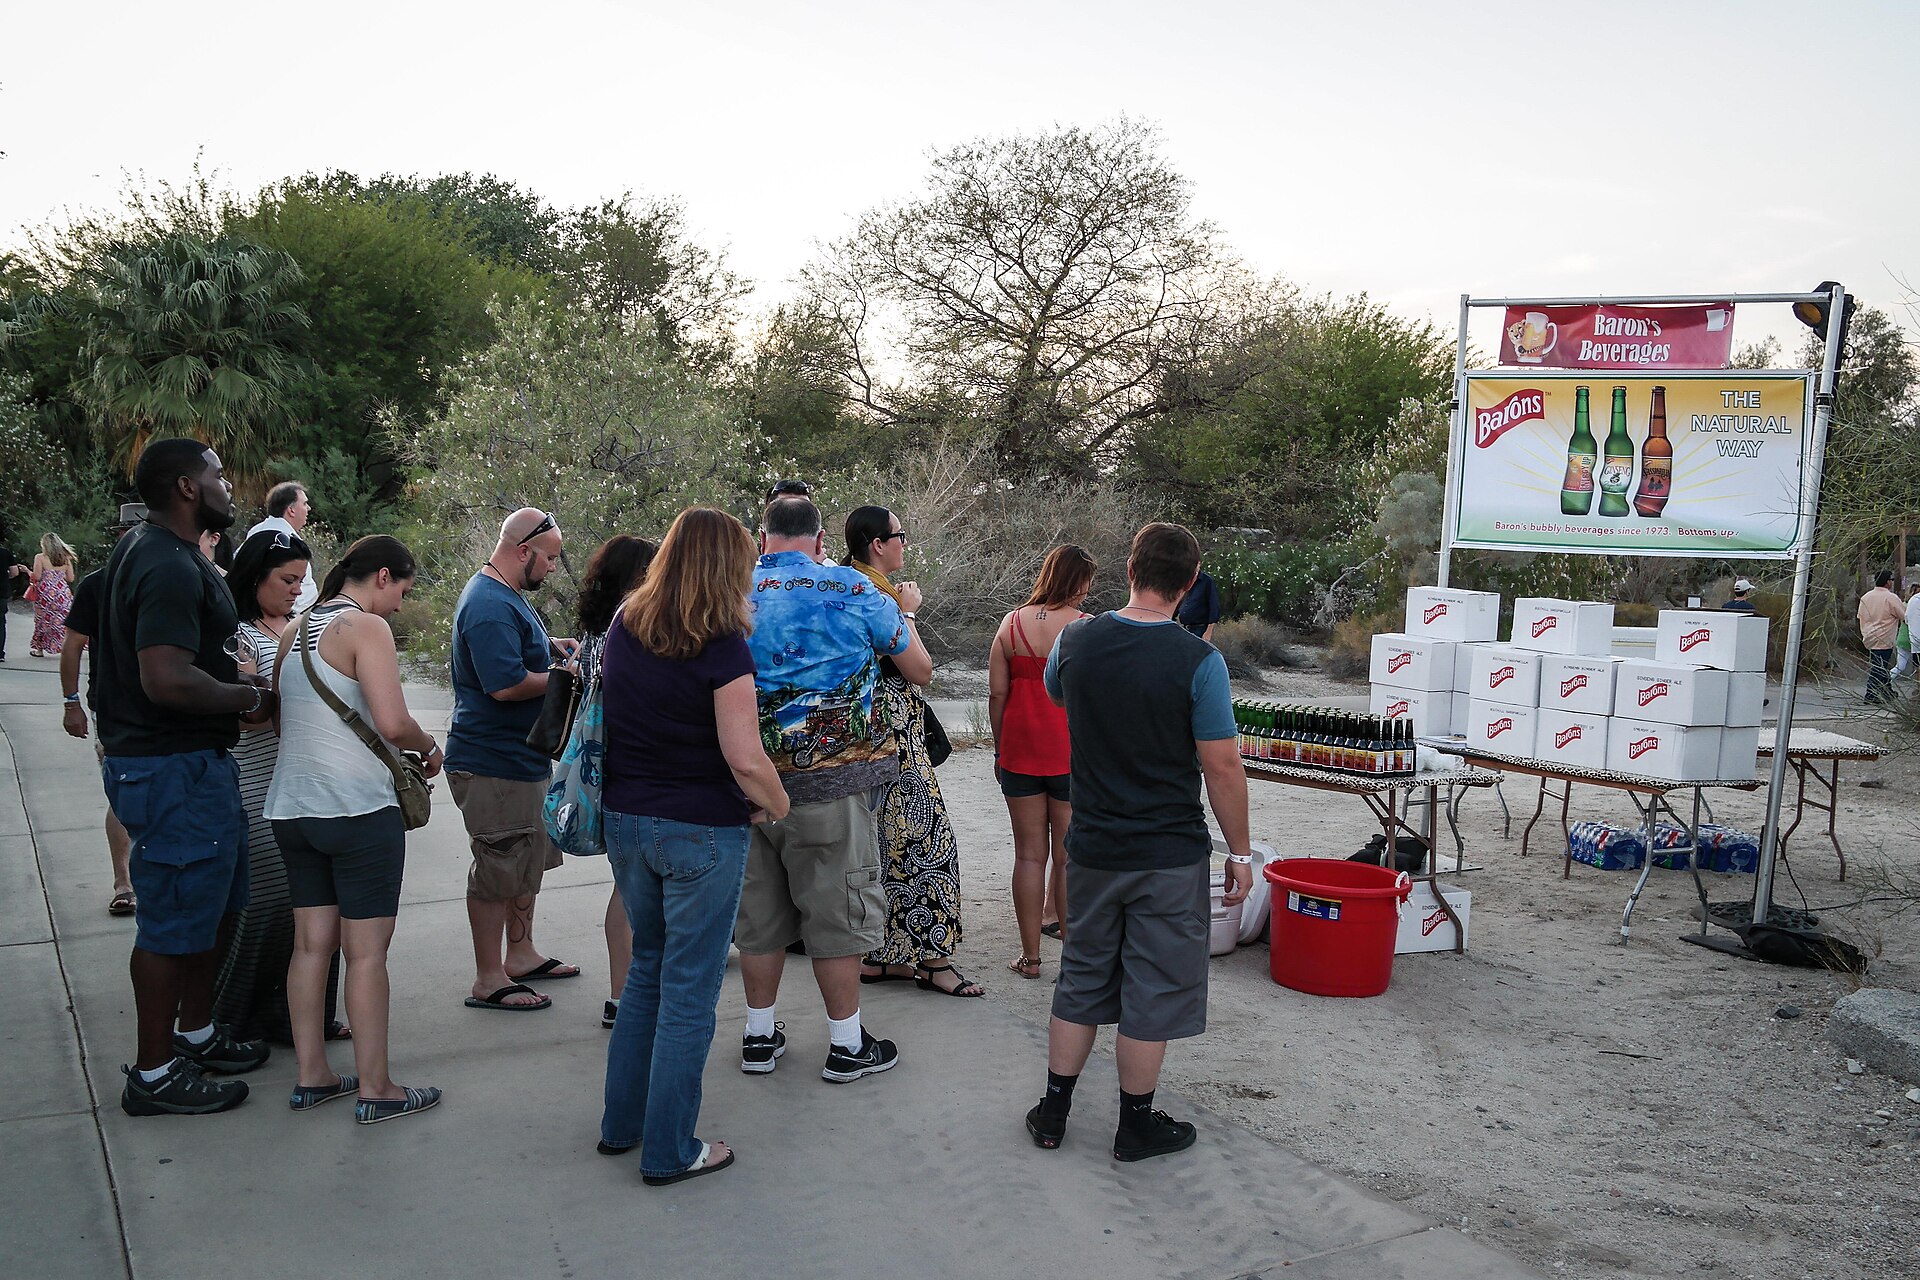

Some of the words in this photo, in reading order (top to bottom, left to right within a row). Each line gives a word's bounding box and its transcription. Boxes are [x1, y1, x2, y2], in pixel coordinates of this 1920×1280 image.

[1593, 314, 1662, 337] Baron's
[1578, 340, 1671, 365] Beverages
[1720, 390, 1761, 408] THE
[1478, 395, 1541, 445] Barons
[1691, 414, 1792, 434] NATURAL
[1716, 439, 1764, 458] WAY
[1495, 521, 1527, 531] Baron's
[1530, 522, 1562, 535] bubbly
[1565, 523, 1614, 536] beverages
[1617, 526, 1641, 535] since
[1645, 527, 1671, 536] 1973.
[1678, 527, 1717, 536] Bottoms
[1425, 606, 1446, 623] Barons
[1533, 618, 1556, 637] Barons
[1681, 631, 1709, 650] Barons
[1389, 656, 1411, 672] Barons
[1491, 669, 1513, 686] Barons
[1562, 677, 1586, 696] Barons
[1639, 686, 1667, 705] Barons
[1489, 720, 1511, 737] Barons
[1556, 729, 1580, 747] Barons
[1630, 739, 1657, 758] Barons
[1423, 912, 1447, 934] Barons
